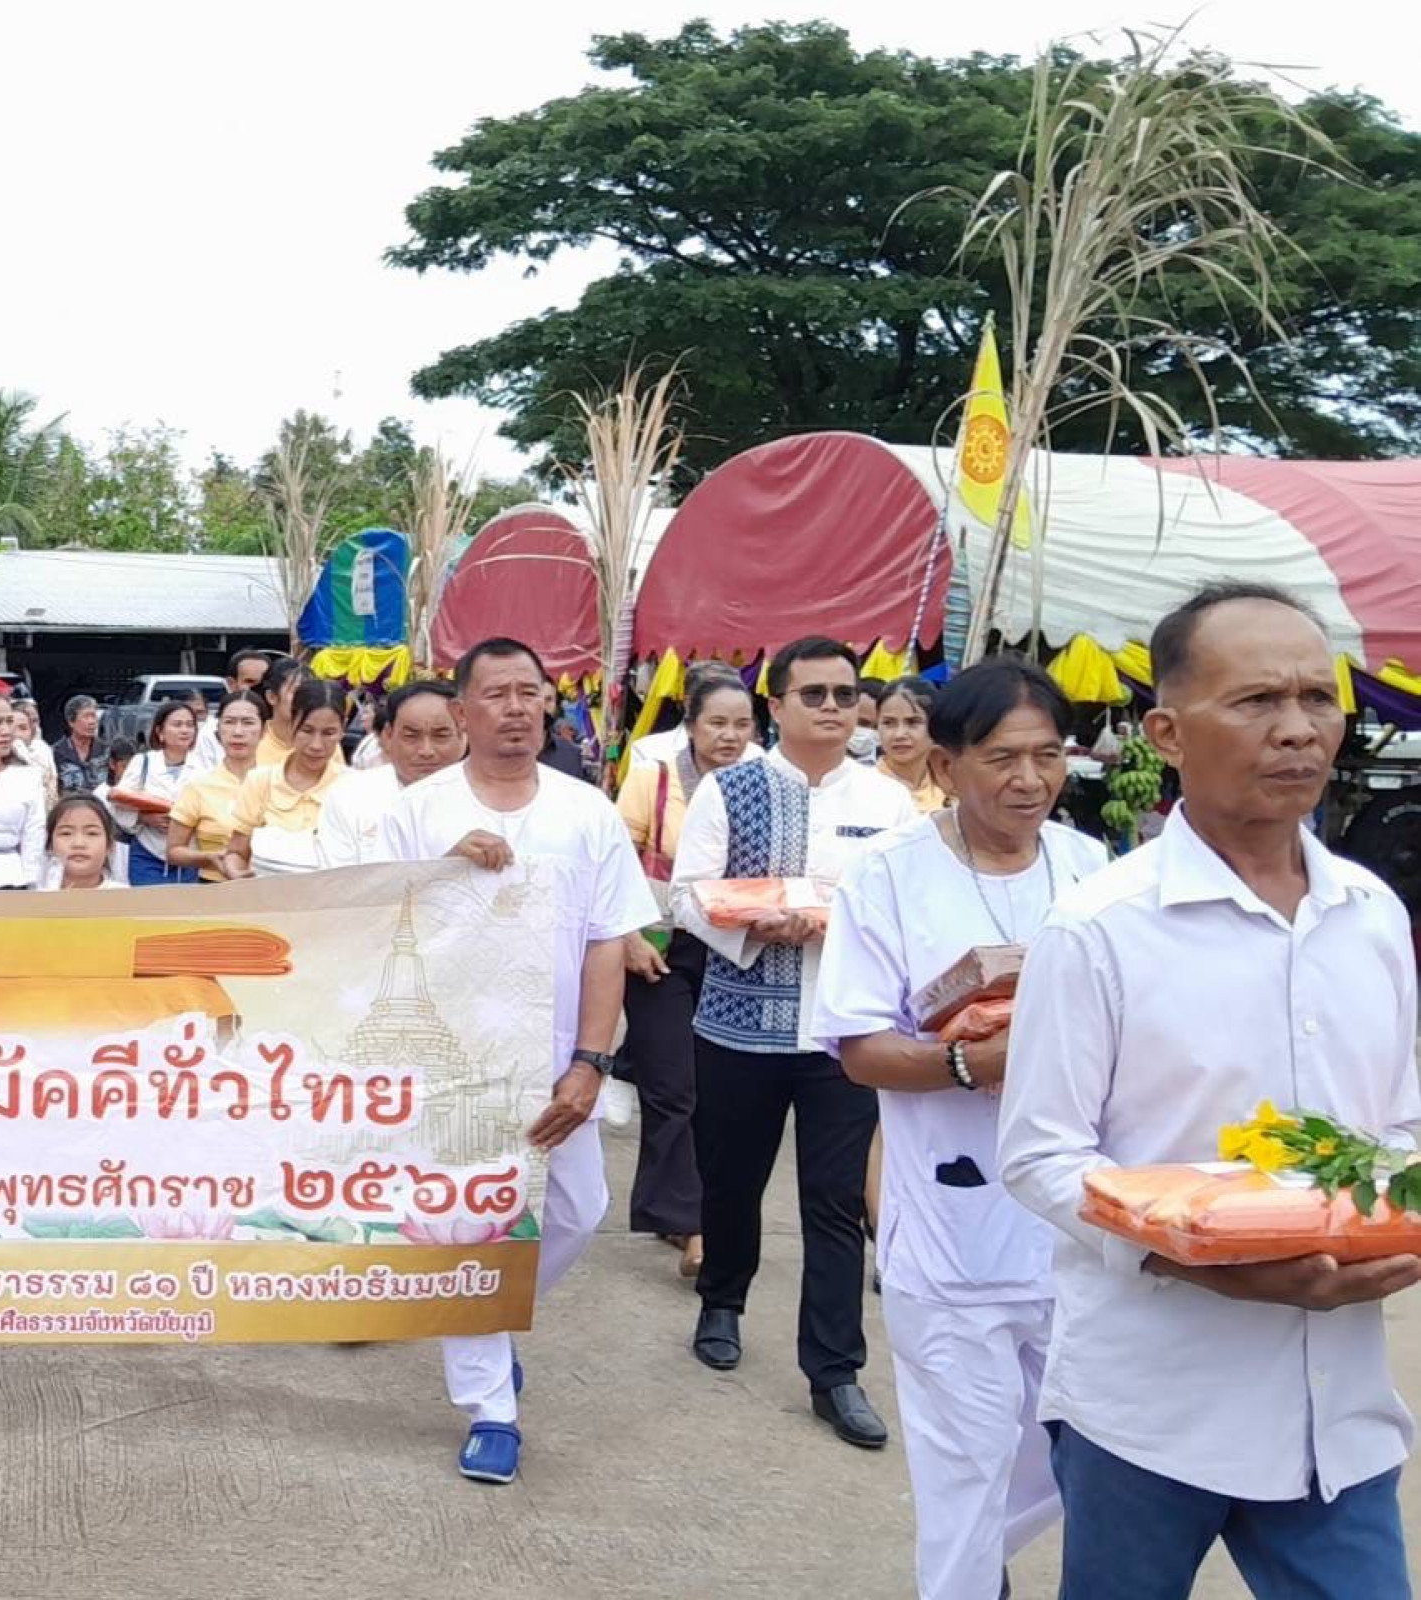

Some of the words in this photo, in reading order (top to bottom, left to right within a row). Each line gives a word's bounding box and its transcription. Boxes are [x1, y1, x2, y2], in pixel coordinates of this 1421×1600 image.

[280, 1159, 519, 1215] ๒๕๖๘
[129, 1273, 177, 1297] ๘๑
[191, 1263, 214, 1297] ปี
[229, 1263, 501, 1299] หลวงพ่อธัมมชโย
